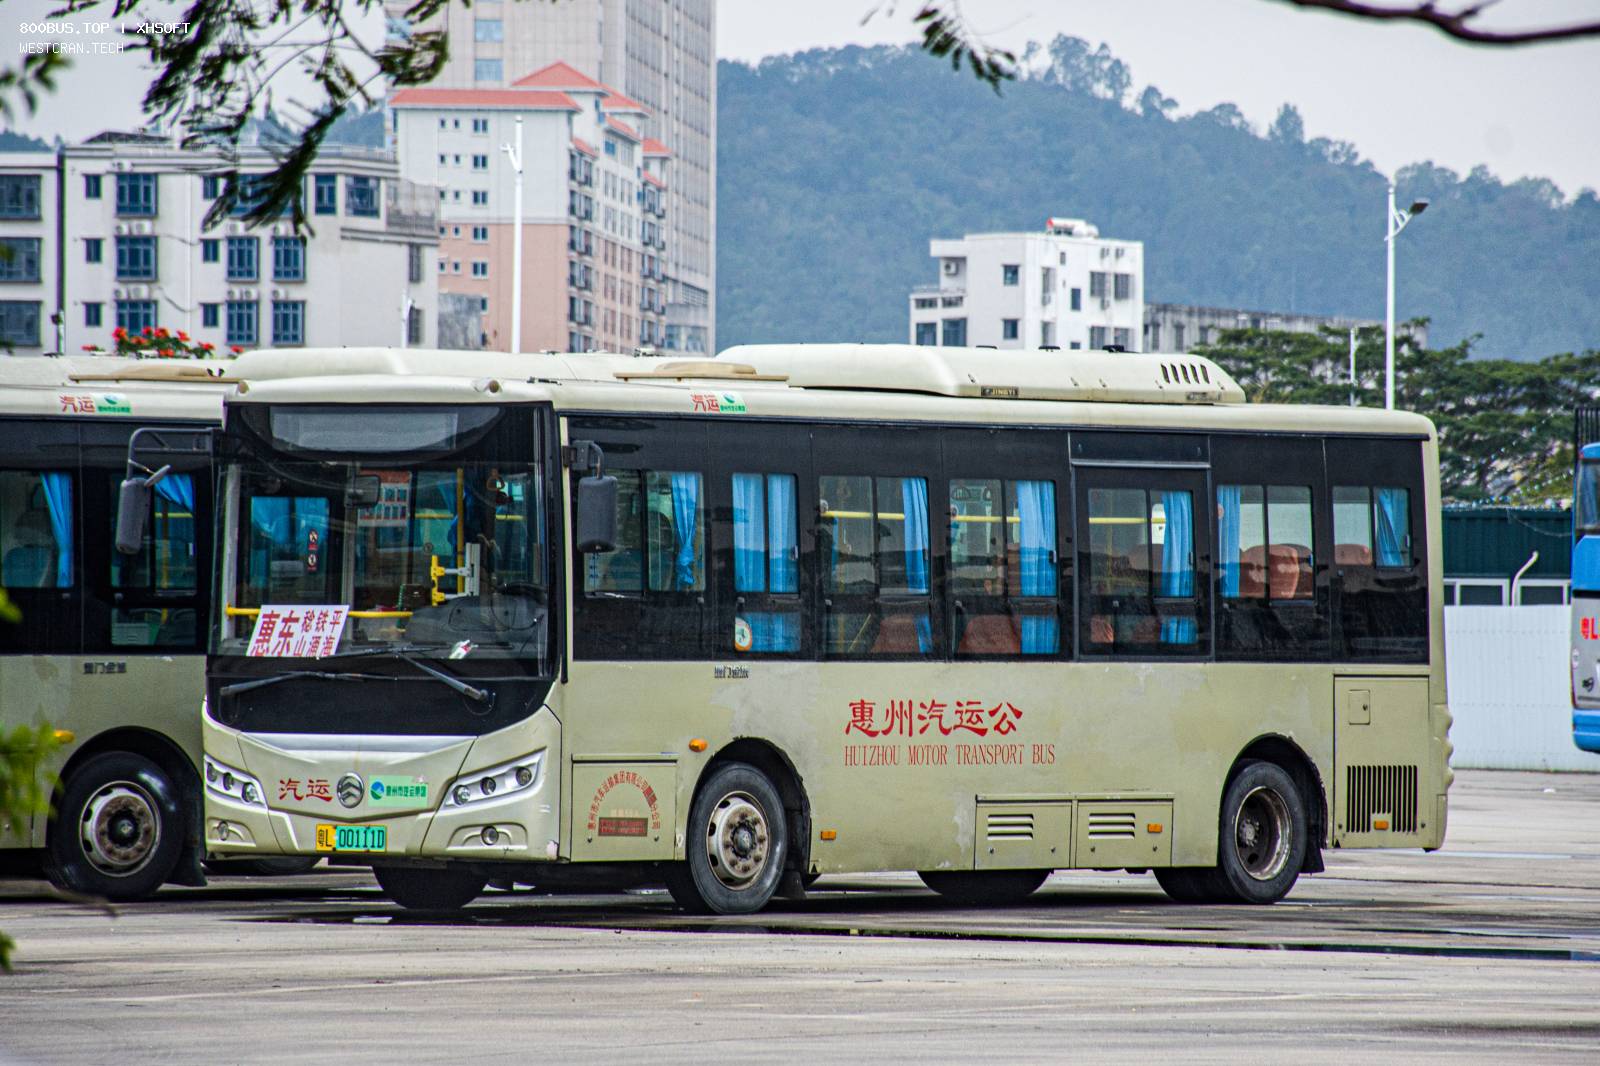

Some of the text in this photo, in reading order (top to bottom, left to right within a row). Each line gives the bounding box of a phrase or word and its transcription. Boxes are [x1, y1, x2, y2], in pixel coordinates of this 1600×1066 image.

[845, 698, 1024, 738] 惠州汽运公
[844, 744, 1056, 767] HUIZHOU MOTOR TRANSPORT BUS
[279, 777, 333, 802] 汽运
